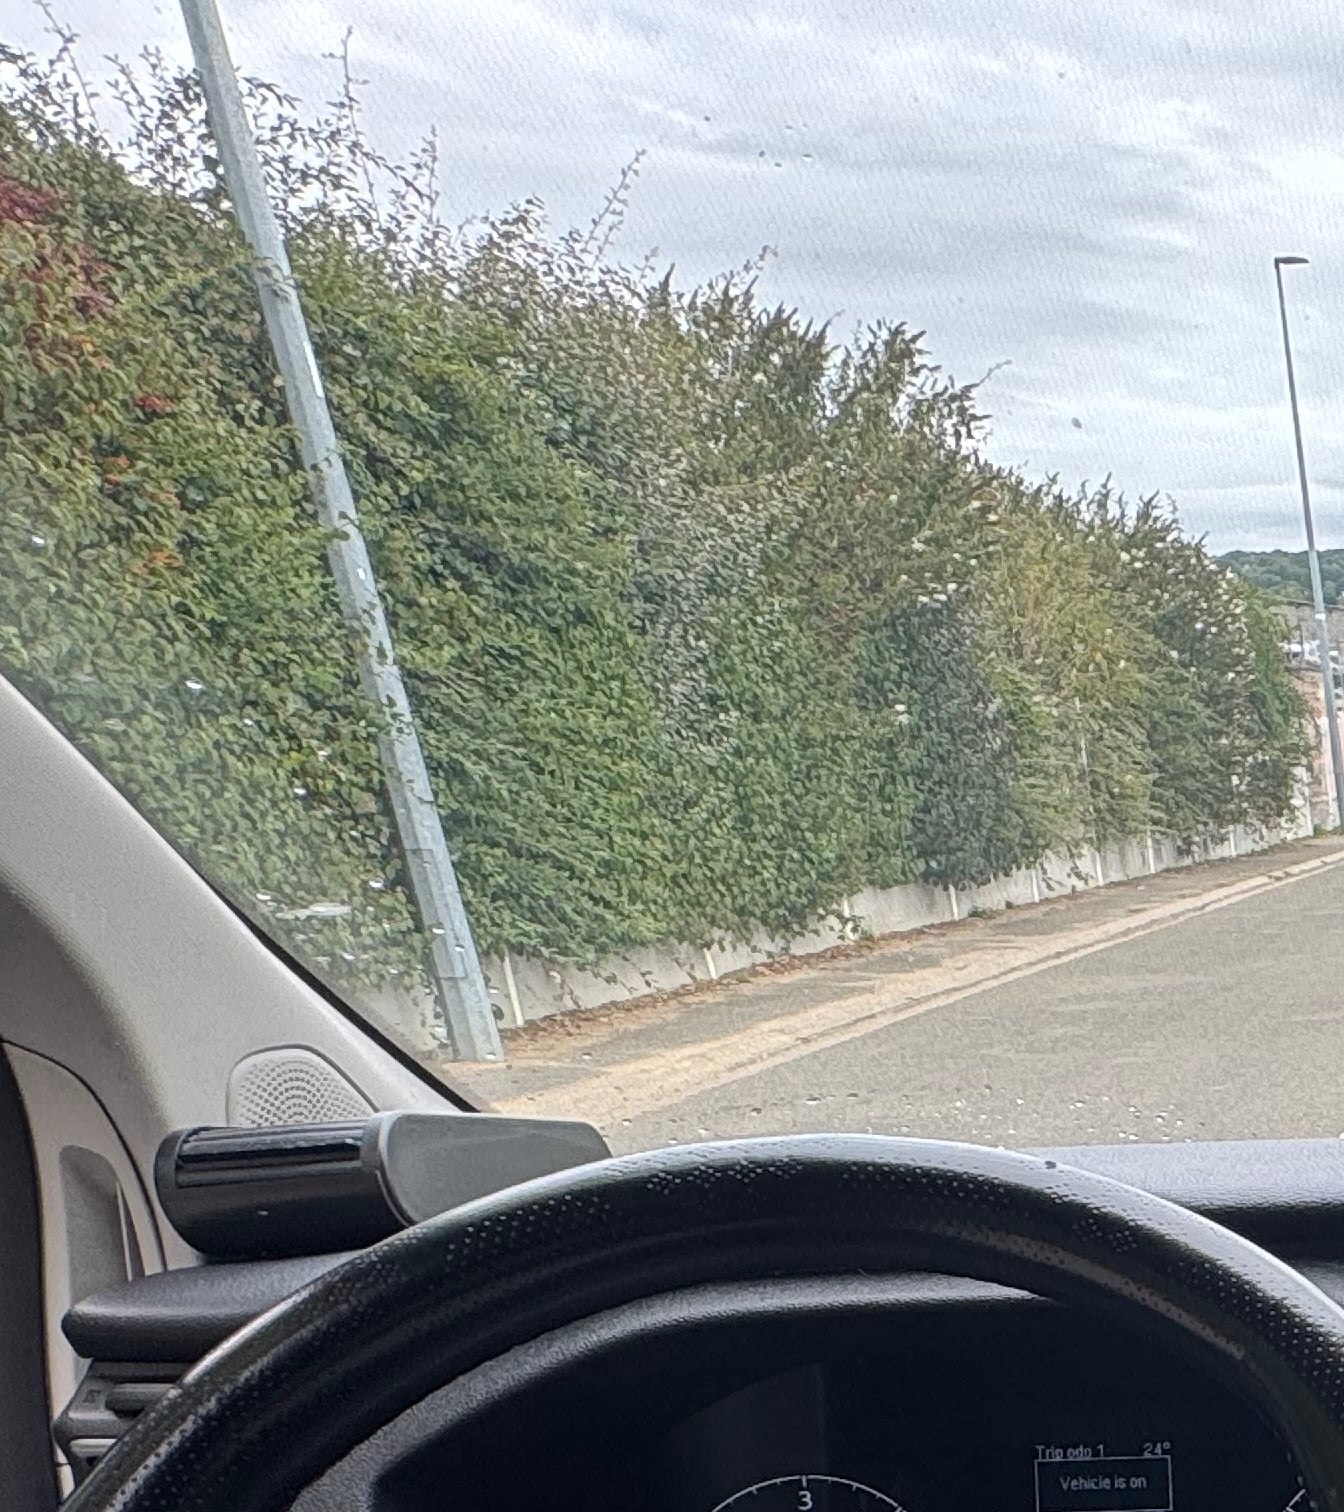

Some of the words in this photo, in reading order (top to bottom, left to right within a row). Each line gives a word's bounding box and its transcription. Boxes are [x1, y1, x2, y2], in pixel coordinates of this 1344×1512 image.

[1035, 1444, 1063, 1460] Trip
[1142, 1440, 1171, 1458] 24°
[1059, 1474, 1112, 1491] Vehicle
[1114, 1473, 1127, 1489] is
[1129, 1475, 1148, 1490] on
[798, 1490, 814, 1511] 3
